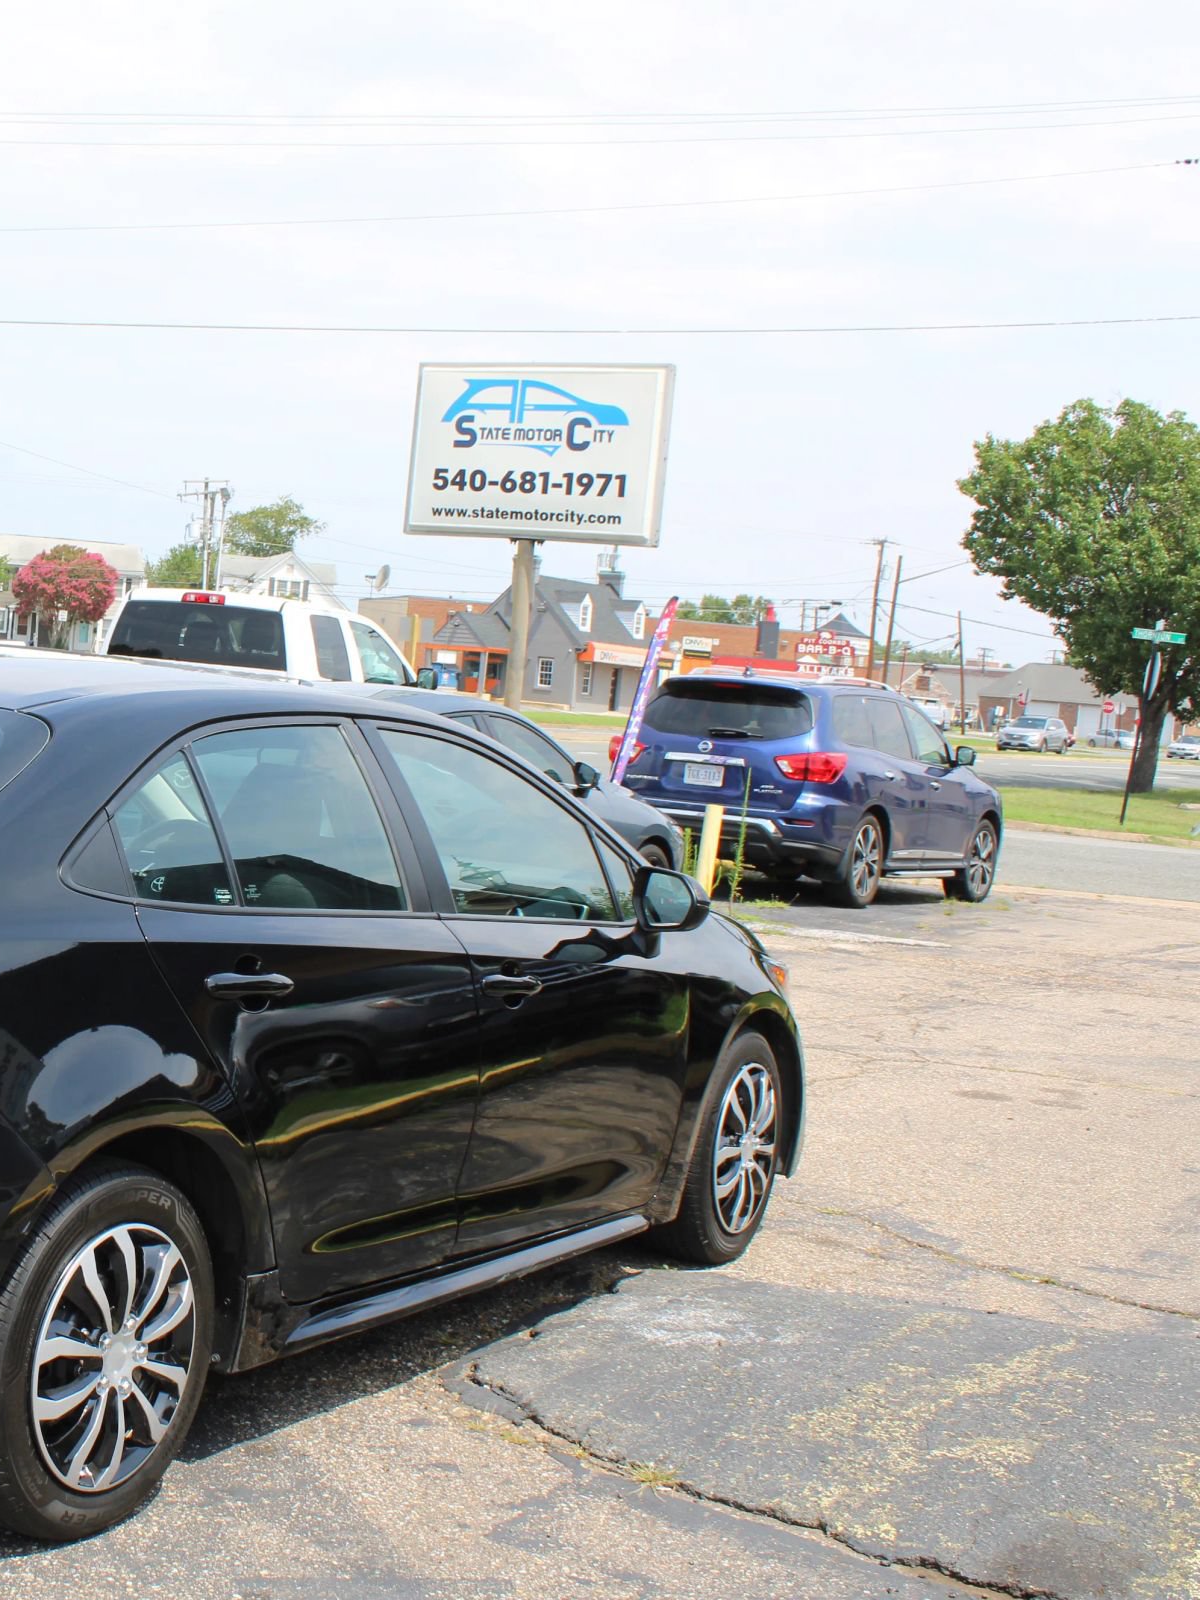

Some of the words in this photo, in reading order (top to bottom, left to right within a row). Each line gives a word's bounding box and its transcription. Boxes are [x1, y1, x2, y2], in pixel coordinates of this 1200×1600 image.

[513, 428, 562, 442] MOTOR
[432, 468, 627, 498] 540-681-1971
[432, 507, 622, 525] www.statemotorcity.com
[797, 643, 851, 656] BAR-B-Q
